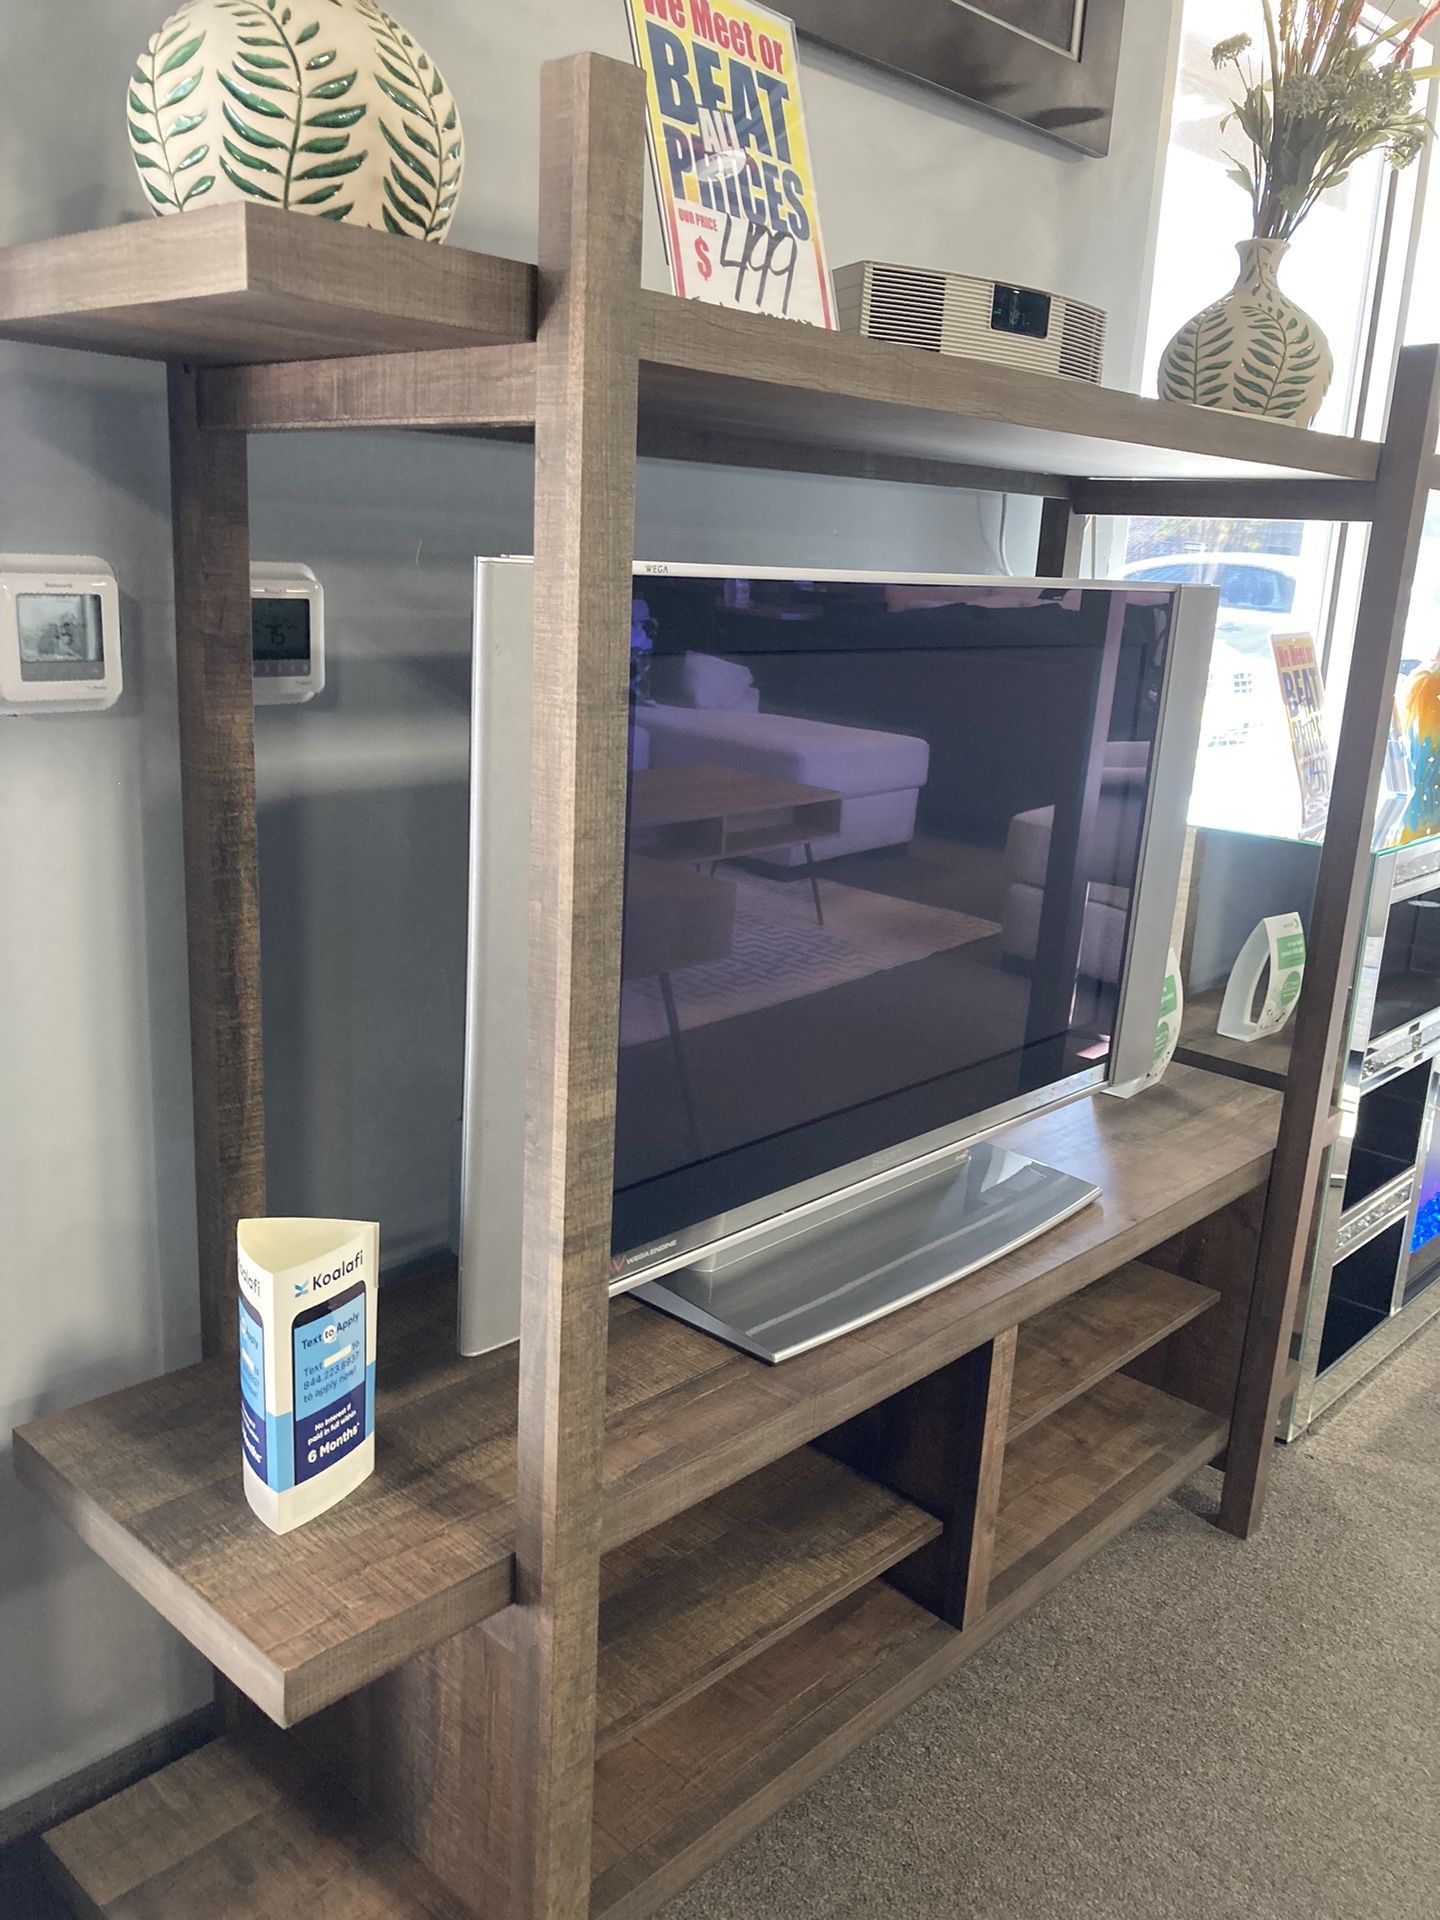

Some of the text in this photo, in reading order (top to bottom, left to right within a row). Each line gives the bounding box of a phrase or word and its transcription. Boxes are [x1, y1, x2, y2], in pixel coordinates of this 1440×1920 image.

[690, 0, 756, 62] Meet
[759, 34, 783, 74] or
[645, 20, 792, 165] BEAT
[698, 107, 740, 153] ALL
[662, 122, 811, 241] PRICES
[678, 208, 718, 232] OUR PRICE
[645, 564, 669, 574] WEGA
[1281, 667, 1321, 718] BEAT
[312, 1249, 363, 1291] Koalafi
[301, 1312, 360, 1350] Text to Apply
[303, 1362, 323, 1377] Text
[303, 1393, 313, 1404] to
[315, 1381, 338, 1398] apply
[314, 1422, 325, 1432] No
[307, 1449, 317, 1463] 6
